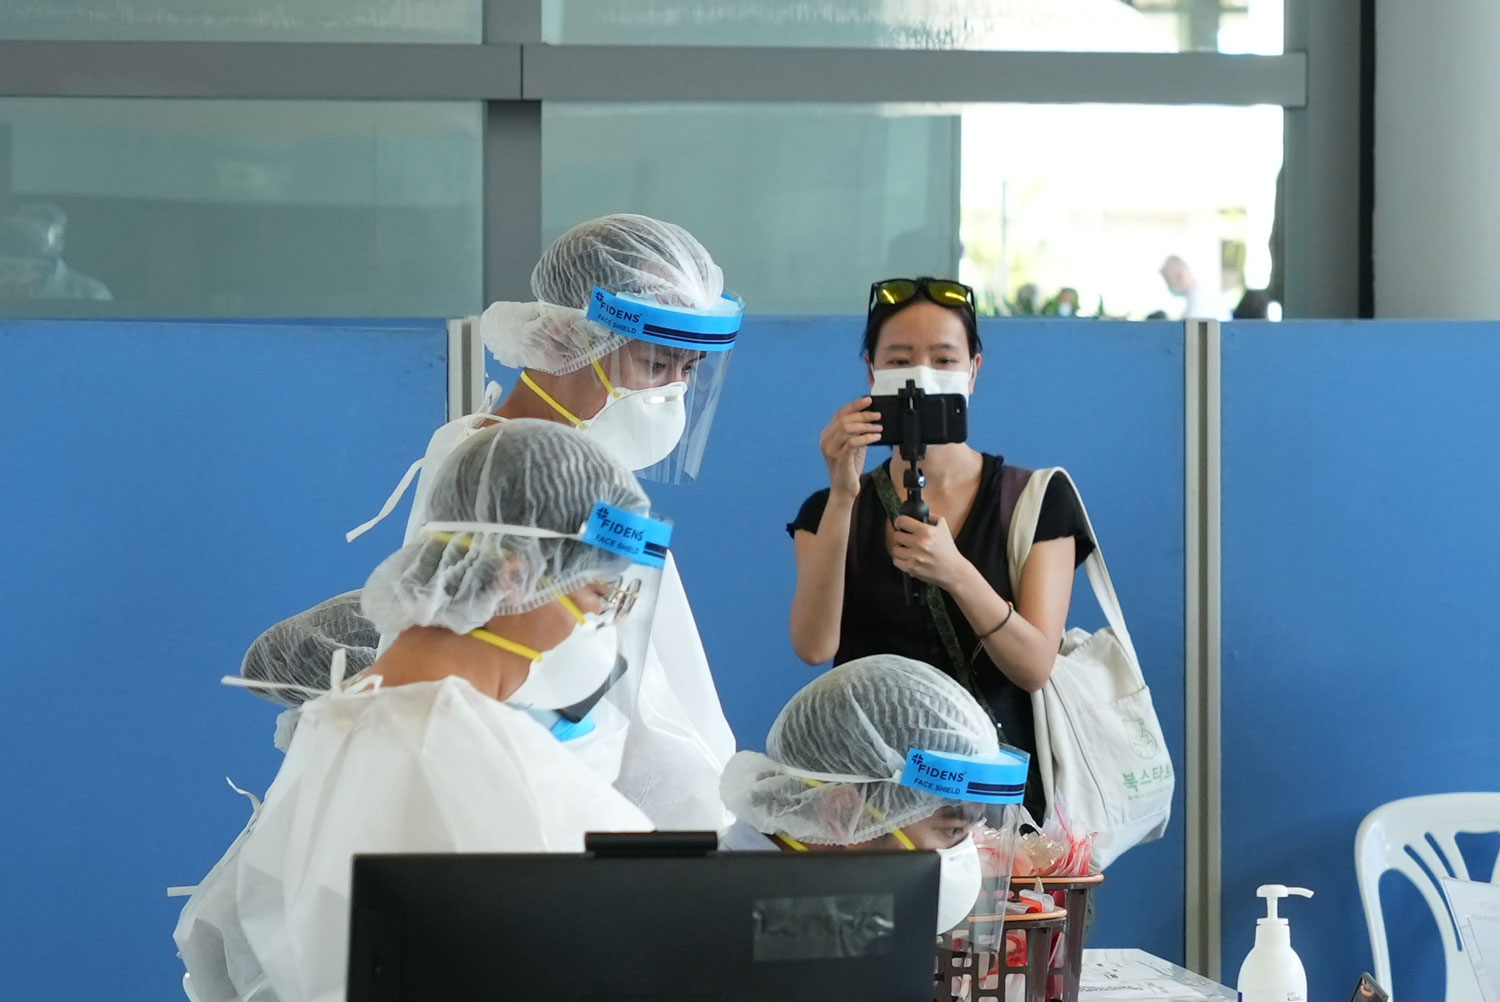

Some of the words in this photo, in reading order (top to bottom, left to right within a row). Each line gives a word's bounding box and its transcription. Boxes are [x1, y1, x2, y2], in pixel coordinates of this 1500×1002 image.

[600, 301, 640, 323] FIDENS
[598, 314, 613, 327] FACE
[612, 322, 637, 334] SHIELD
[600, 519, 644, 541] FIDENS
[595, 534, 617, 547] FACE
[918, 763, 965, 783] FIDENS
[913, 777, 935, 790] FACE
[935, 784, 961, 795] SHIELD
